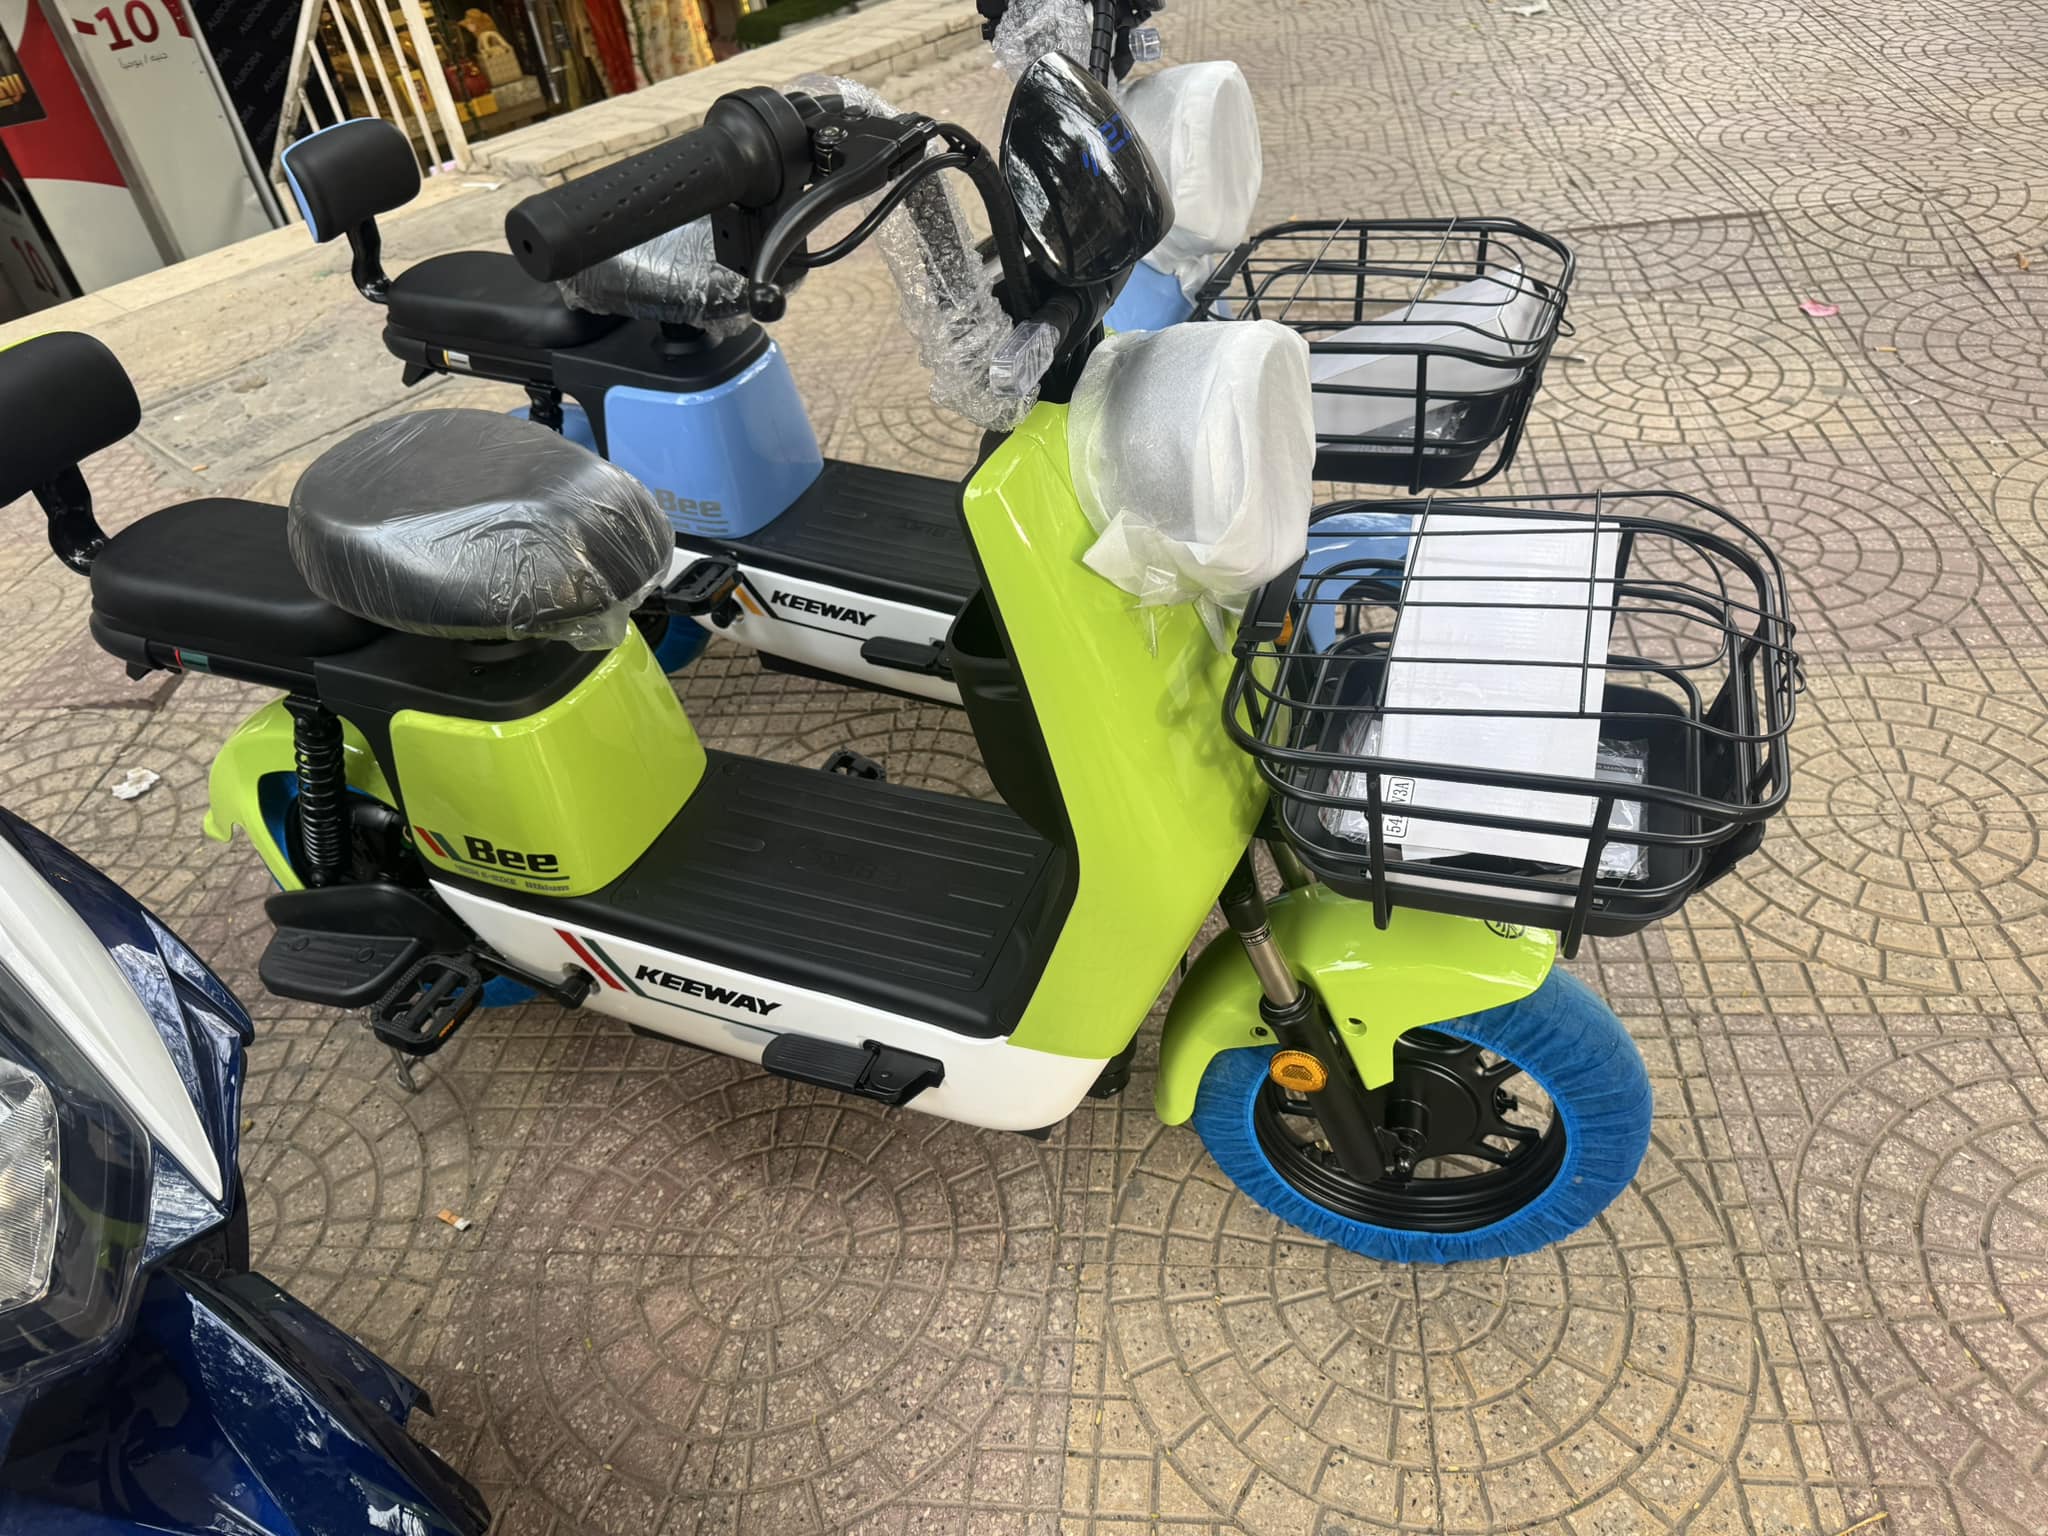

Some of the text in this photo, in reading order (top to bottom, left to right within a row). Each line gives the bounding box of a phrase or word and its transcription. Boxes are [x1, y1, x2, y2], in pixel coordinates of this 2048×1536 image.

[655, 487, 722, 518] Bee
[770, 589, 876, 627] KEEWAY
[463, 834, 559, 873] Bee
[634, 964, 783, 1016] KEEWAY
